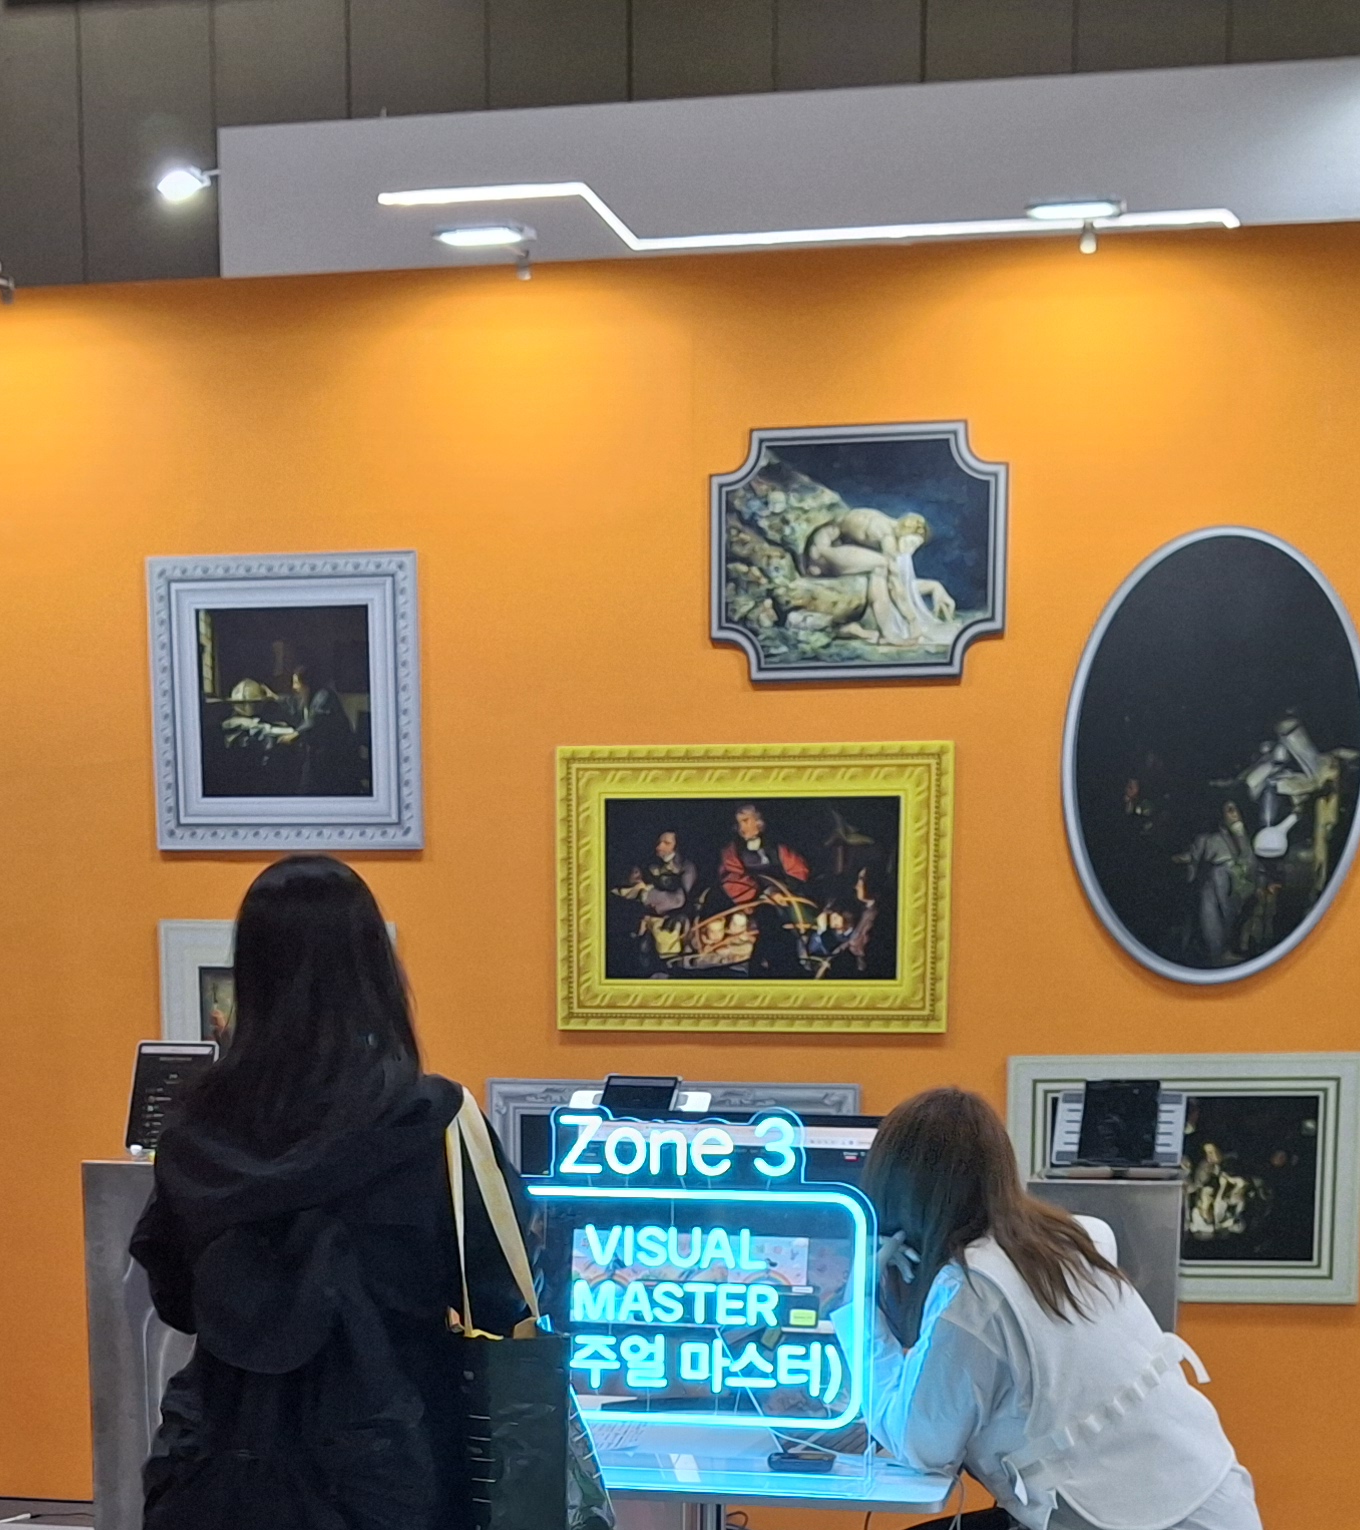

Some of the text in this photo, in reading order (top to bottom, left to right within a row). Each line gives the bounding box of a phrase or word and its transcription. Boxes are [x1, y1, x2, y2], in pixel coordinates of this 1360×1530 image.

[558, 1114, 797, 1178] Zone 3
[584, 1223, 768, 1271] VISUAL
[572, 1279, 780, 1328] MASTER
[679, 1336, 845, 1405] 마스터)
